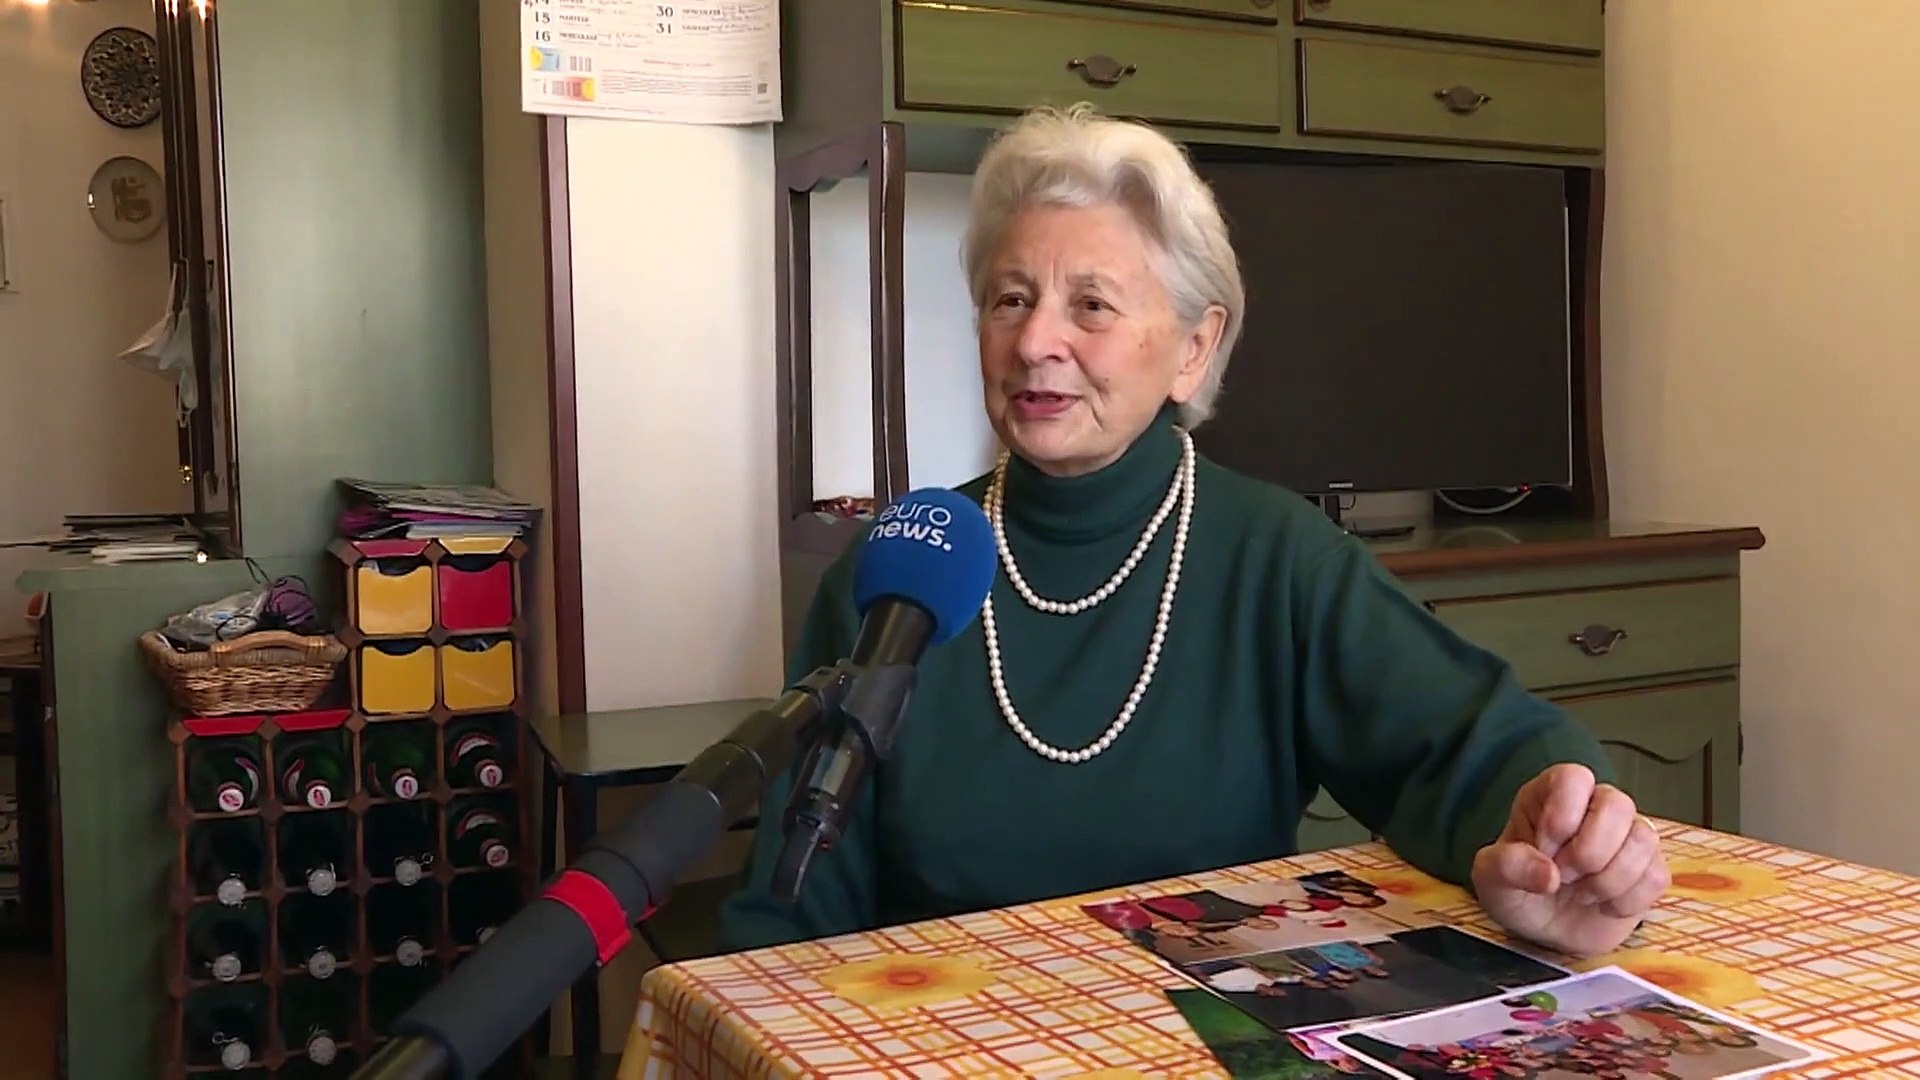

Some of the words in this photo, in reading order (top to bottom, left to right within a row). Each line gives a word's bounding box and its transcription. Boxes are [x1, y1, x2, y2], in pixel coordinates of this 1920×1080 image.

[656, 5, 674, 17] 30
[535, 11, 551, 24] 15
[656, 22, 672, 34] 31
[535, 30, 551, 42] 16
[879, 503, 952, 526] euro
[868, 521, 952, 551] news.
